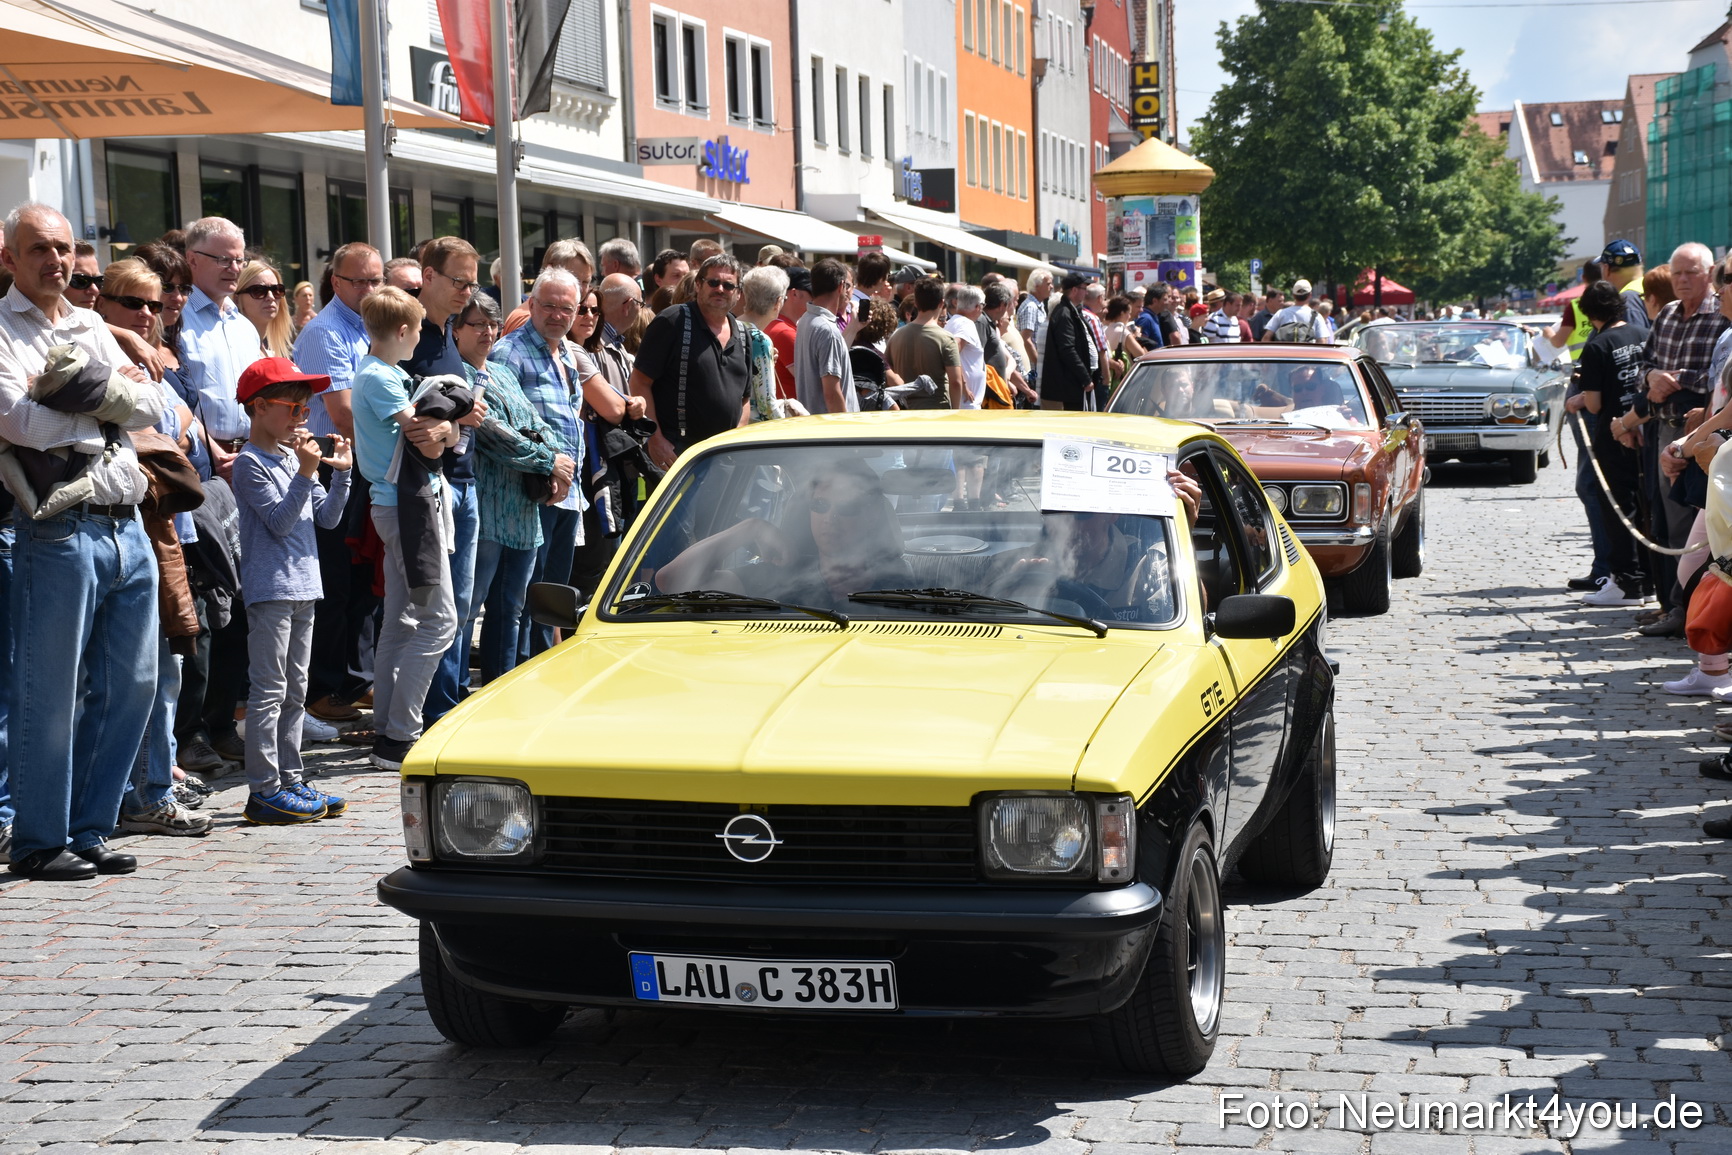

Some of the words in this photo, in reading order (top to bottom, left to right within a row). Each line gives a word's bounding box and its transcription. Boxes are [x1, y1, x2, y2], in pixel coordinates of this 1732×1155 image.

[642, 981, 651, 992] D
[656, 960, 731, 1000] LAU
[758, 966, 784, 1002] C
[791, 967, 893, 1003] 383H
